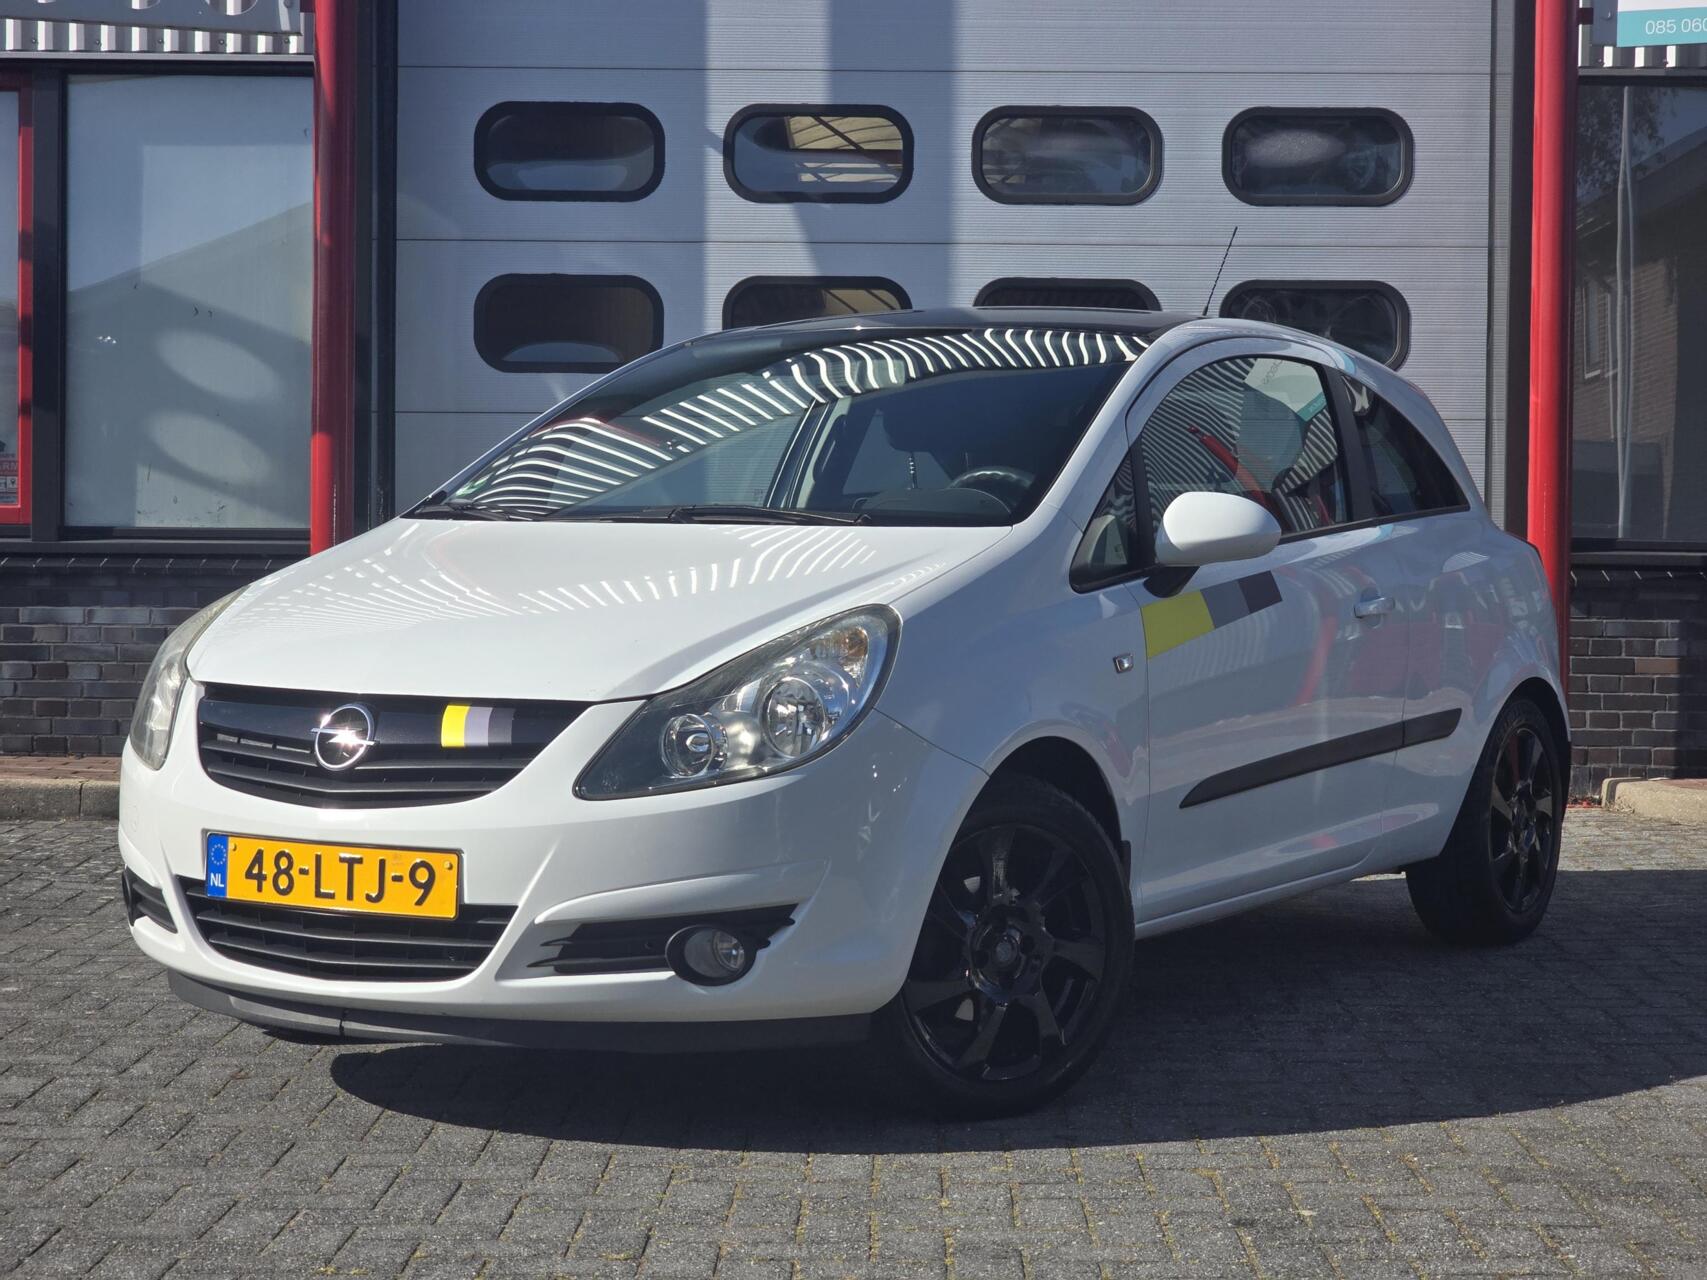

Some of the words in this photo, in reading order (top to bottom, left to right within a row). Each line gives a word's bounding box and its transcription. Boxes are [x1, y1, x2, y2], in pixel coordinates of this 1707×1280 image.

[1645, 19, 1677, 35] 085
[210, 872, 225, 888] NL
[244, 848, 436, 906] 48-LTJ-9
